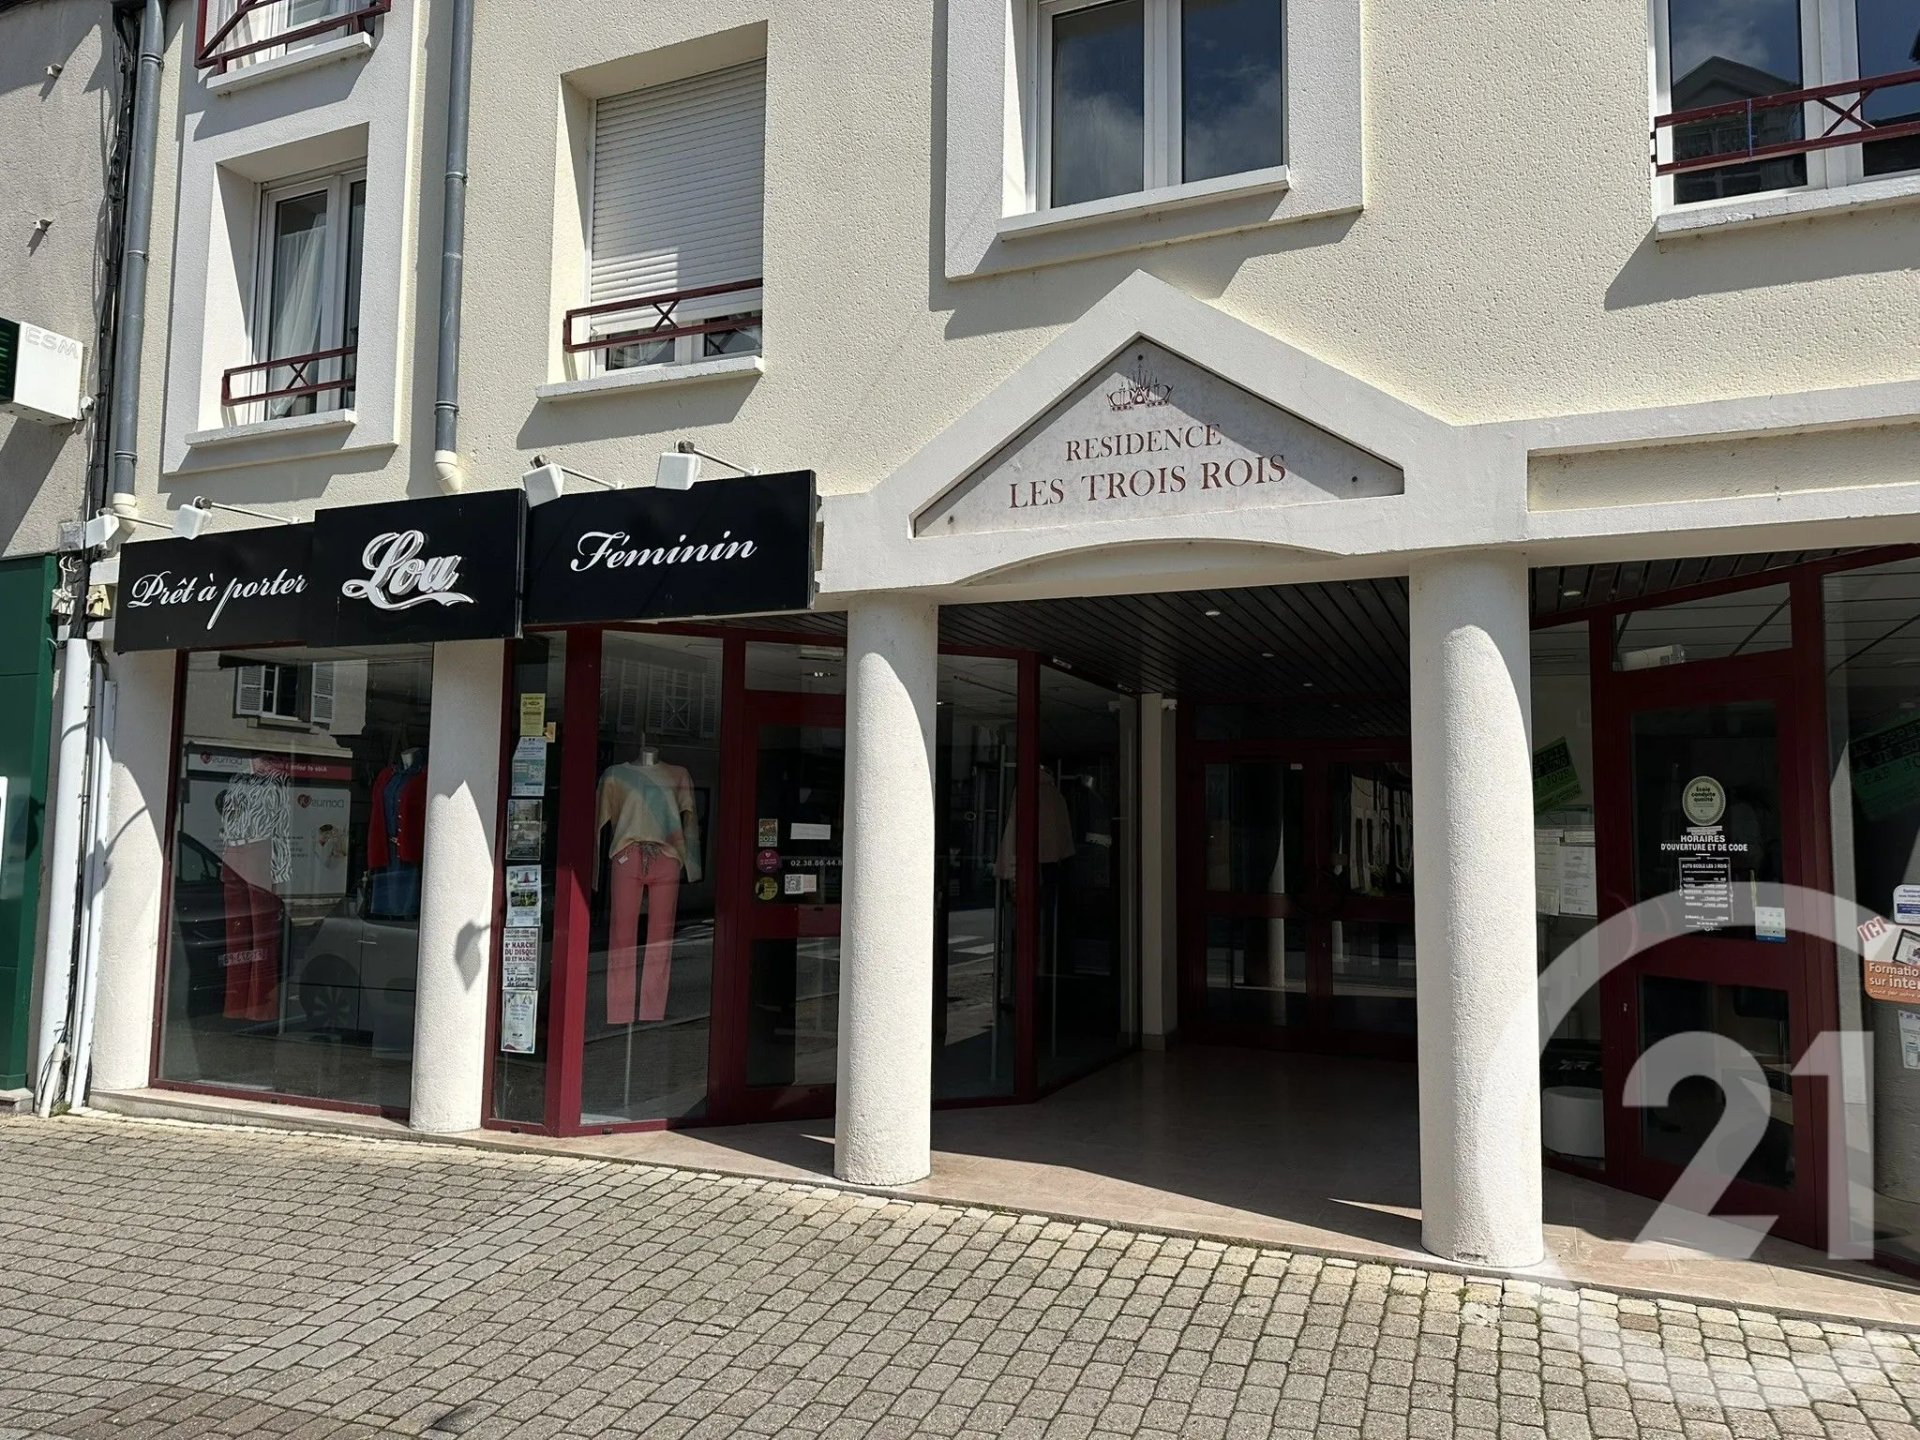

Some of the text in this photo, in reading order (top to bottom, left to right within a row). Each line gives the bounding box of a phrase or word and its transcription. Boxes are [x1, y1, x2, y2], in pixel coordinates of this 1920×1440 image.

[1066, 423, 1222, 462] RESIDENCE
[1009, 454, 1287, 509] LES TROIS ROIS
[341, 529, 475, 611] Lou
[569, 529, 759, 573] Féminin
[127, 568, 309, 630] Prêt à porter
[1660, 843, 1749, 852] D'OUVERTURE ET DE CODE
[1680, 835, 1726, 843] HORAIRES
[1857, 916, 1888, 944] ICI
[1869, 976, 1886, 986] sur
